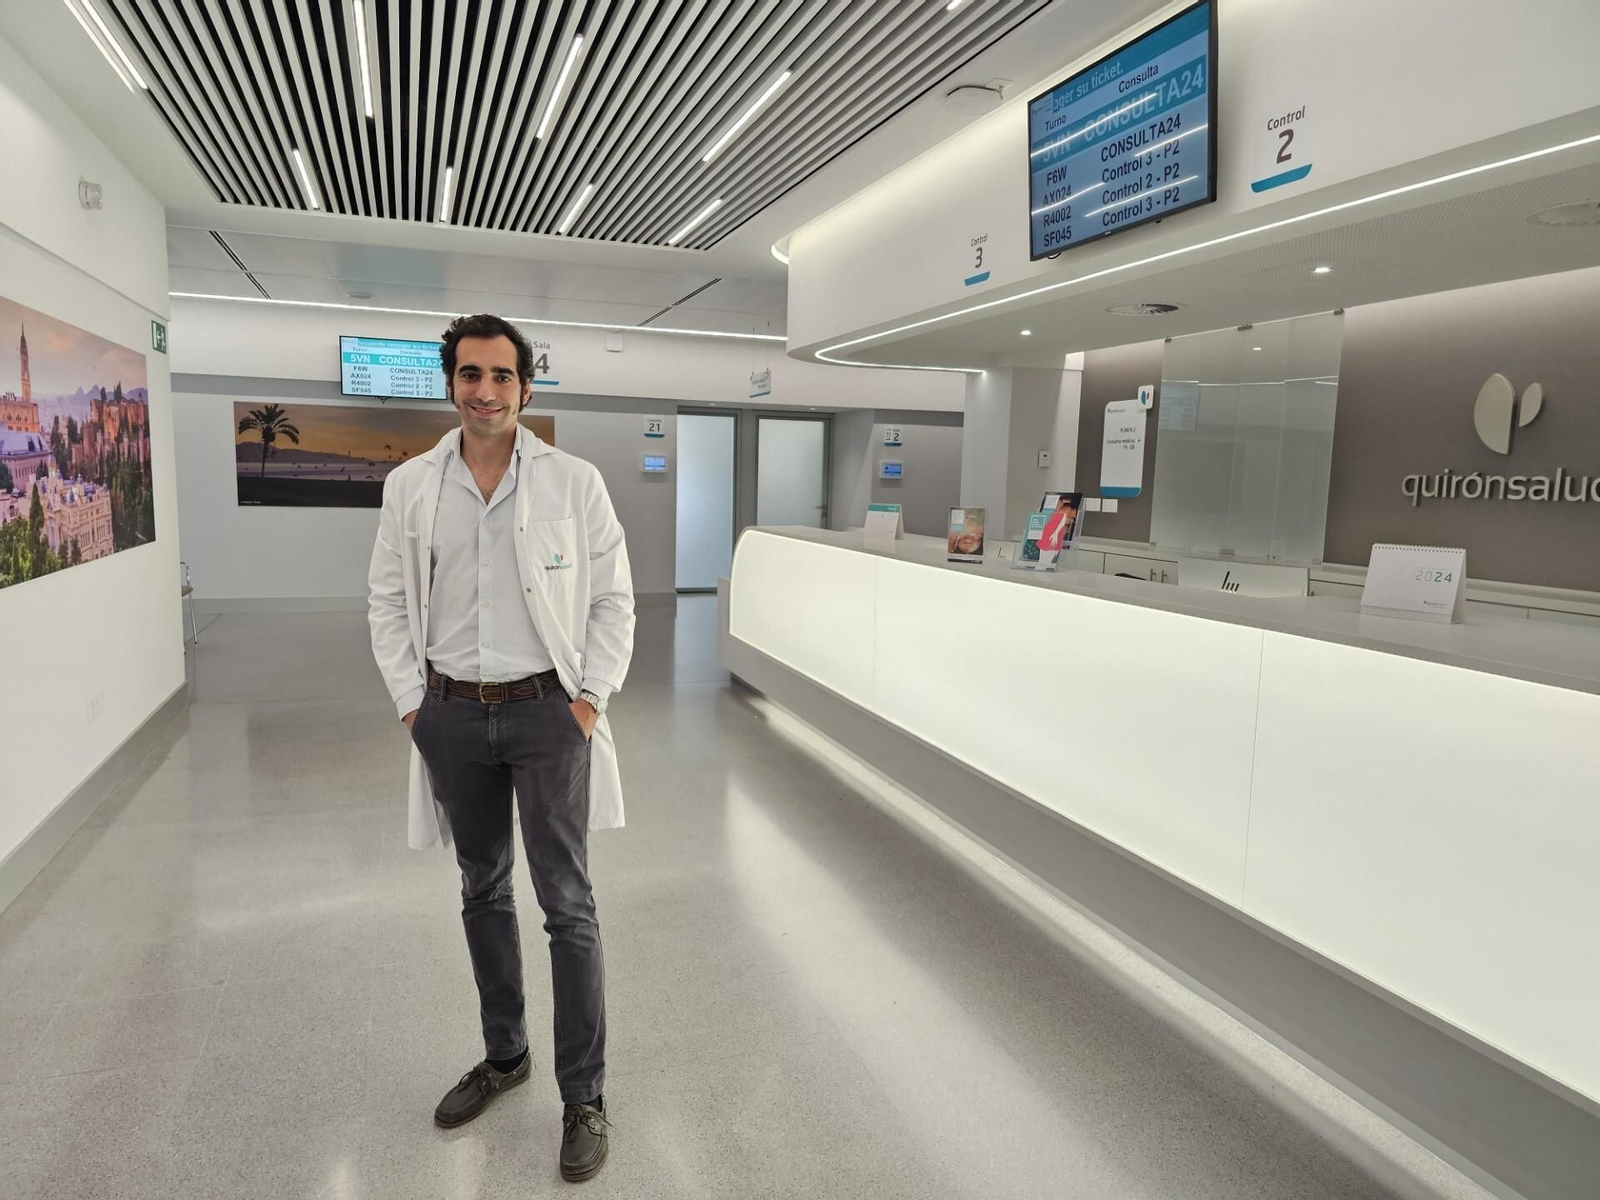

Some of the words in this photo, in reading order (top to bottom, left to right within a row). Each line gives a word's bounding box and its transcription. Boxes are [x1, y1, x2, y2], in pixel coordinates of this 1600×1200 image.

[1076, 83, 1089, 99] su
[1091, 62, 1124, 89] ticket.
[1045, 114, 1067, 132] Turno
[1118, 65, 1159, 93] Consulta
[1084, 63, 1204, 142] CONSULTA24
[1267, 105, 1306, 131] Control
[1046, 165, 1068, 187] F6W
[1101, 113, 1181, 162] CONSULTA24
[1276, 128, 1294, 164] 2
[1043, 184, 1072, 207] AX024
[1102, 154, 1142, 183] Control
[1146, 149, 1153, 166] 3
[1164, 138, 1180, 159] P2
[1043, 205, 1072, 228] R4002
[1102, 180, 1142, 205] Control
[1146, 173, 1153, 189] 2
[1164, 162, 1180, 181] P2
[1043, 226, 1072, 248] SF045
[1102, 203, 1142, 227] Control
[1146, 196, 1153, 212] 3
[1164, 186, 1180, 206] P2
[971, 232, 988, 247] Control
[975, 246, 983, 269] 3
[533, 341, 551, 350] Sala
[350, 354, 371, 363] 5VN
[533, 353, 550, 374] 4
[389, 367, 433, 375] CONSULTA24
[649, 422, 660, 432] 21
[893, 432, 900, 442] 2
[1415, 569, 1453, 583] 2024
